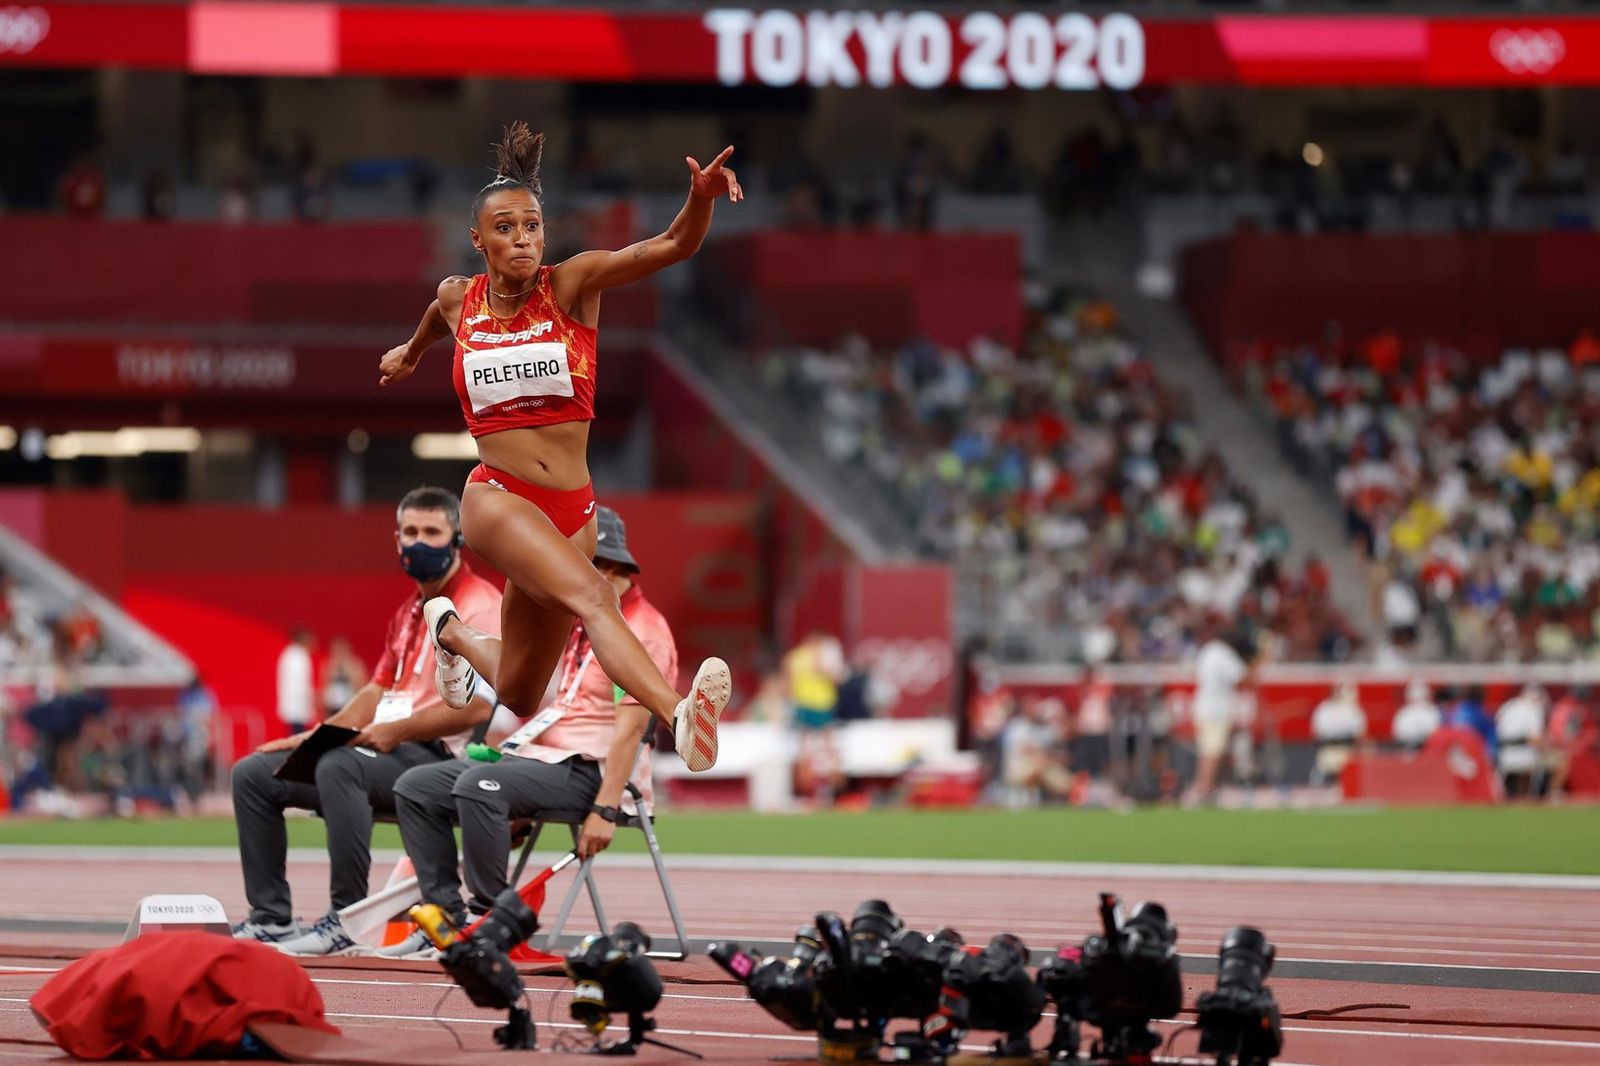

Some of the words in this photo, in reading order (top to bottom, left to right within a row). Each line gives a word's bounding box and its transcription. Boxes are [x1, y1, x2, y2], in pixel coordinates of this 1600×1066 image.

[704, 10, 952, 88] TOKYO
[959, 11, 1146, 91] 2020
[472, 359, 561, 386] PELETEIRO
[147, 905, 174, 915] TOKYO
[175, 905, 195, 914] 2020
